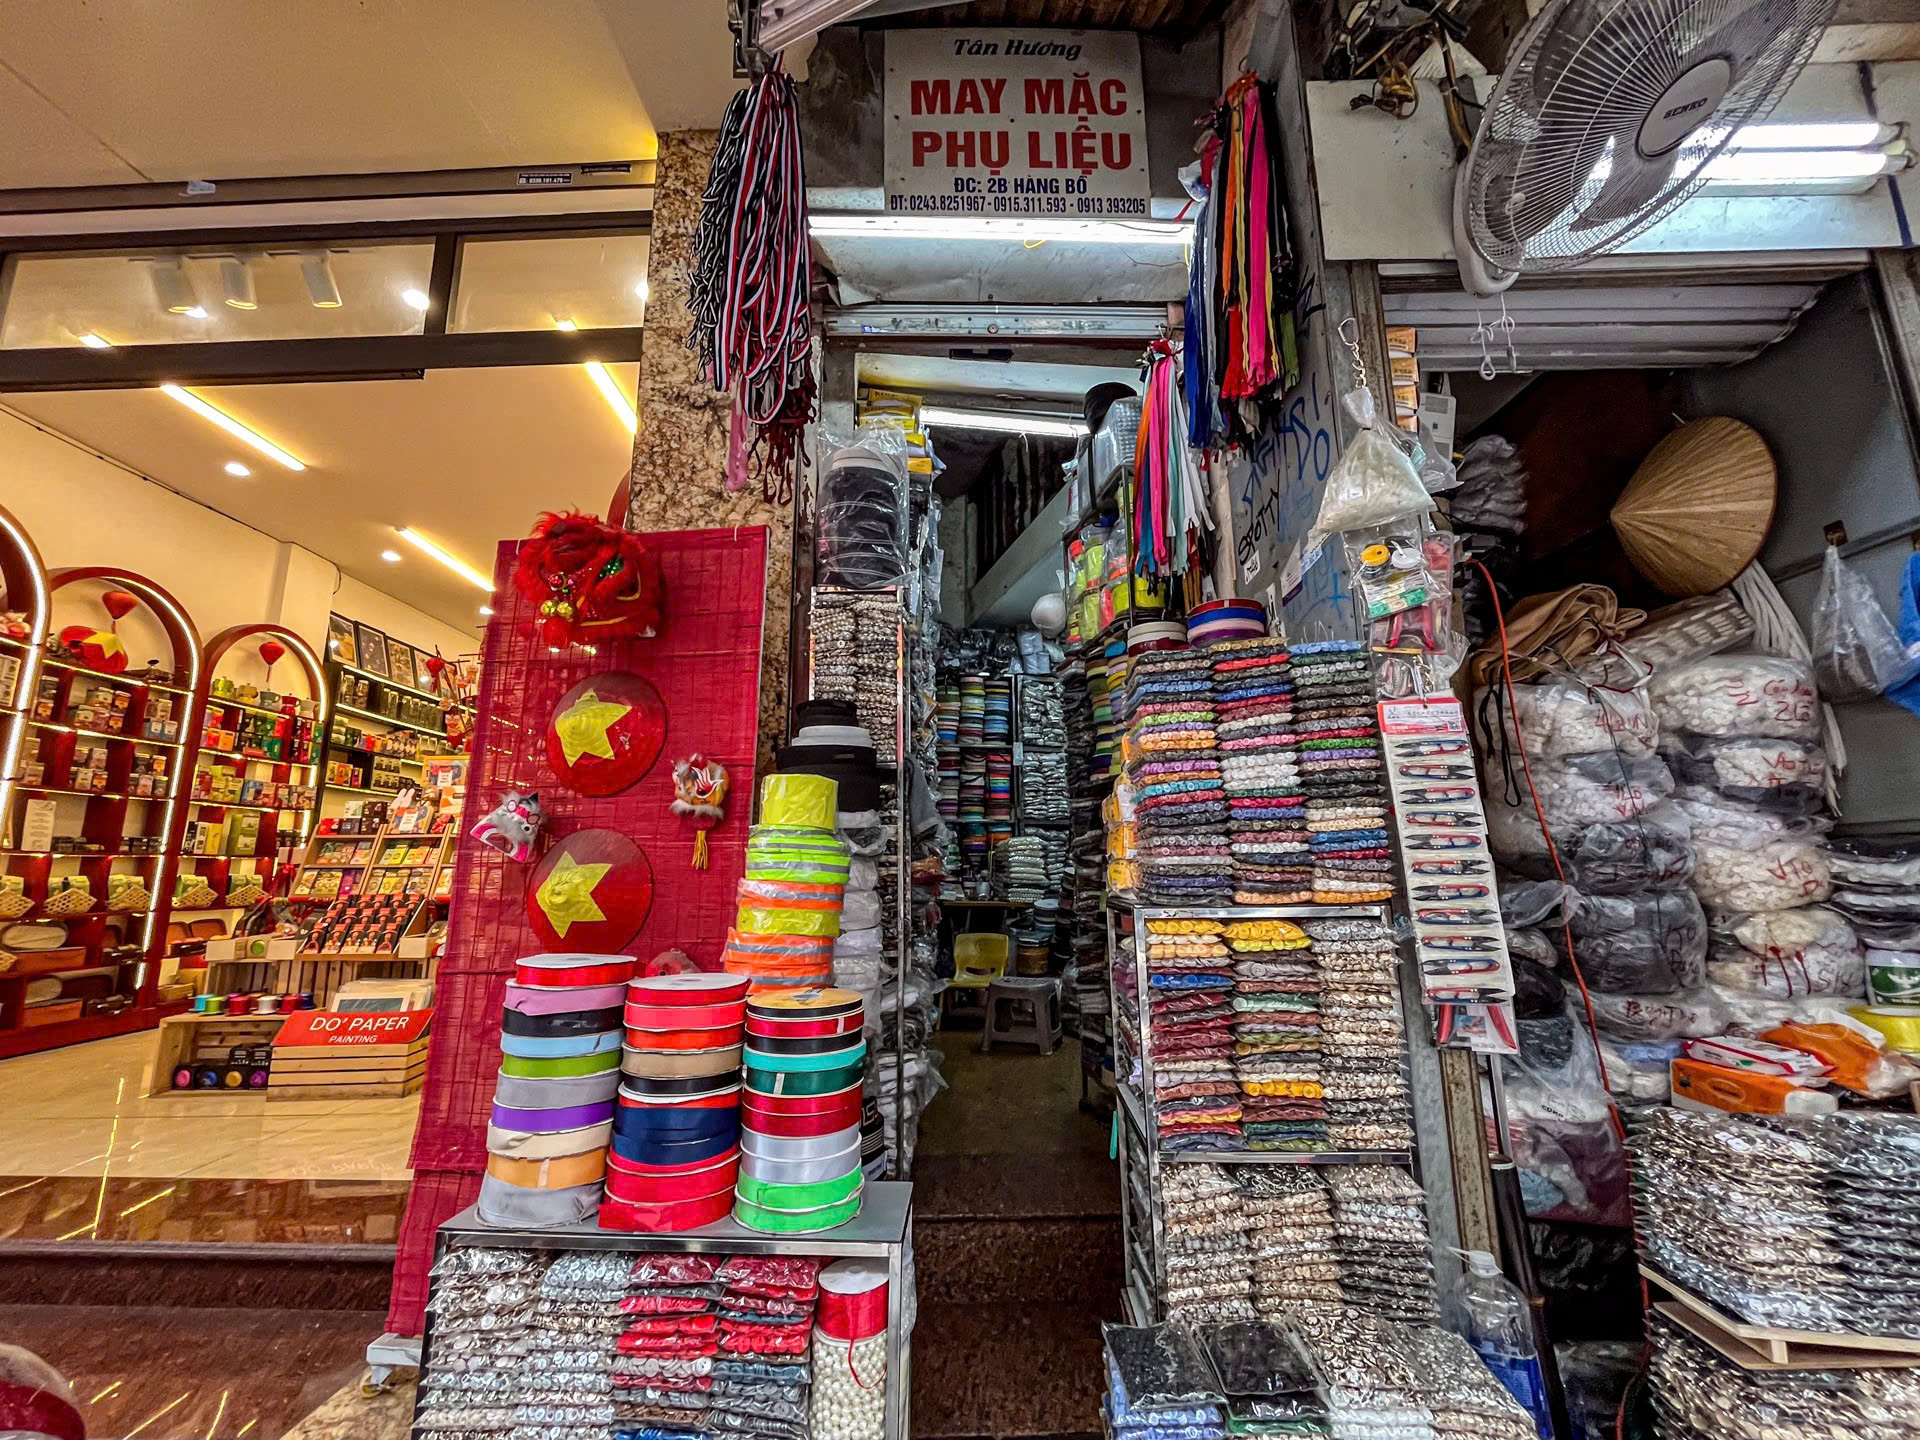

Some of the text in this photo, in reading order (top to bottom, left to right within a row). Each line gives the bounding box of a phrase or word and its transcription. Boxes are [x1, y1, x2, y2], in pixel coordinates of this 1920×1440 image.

[954, 38, 1082, 61] Tân Hương
[911, 72, 1128, 122] MAY MẶC
[1663, 97, 1708, 119] SENKO
[912, 124, 1132, 176] PHỤ LIỆU
[954, 177, 982, 193] ĐC:
[987, 177, 1008, 194] 2B
[1014, 175, 1059, 194] HÀNG
[891, 195, 907, 211] ĐT:
[909, 195, 986, 212] 0243.8251967
[993, 196, 1067, 212] 0915.311.593
[1077, 197, 1103, 213] 0913
[1106, 197, 1146, 214] 393205
[348, 1016, 410, 1031] PAPER
[328, 1034, 378, 1044] PAINTING
